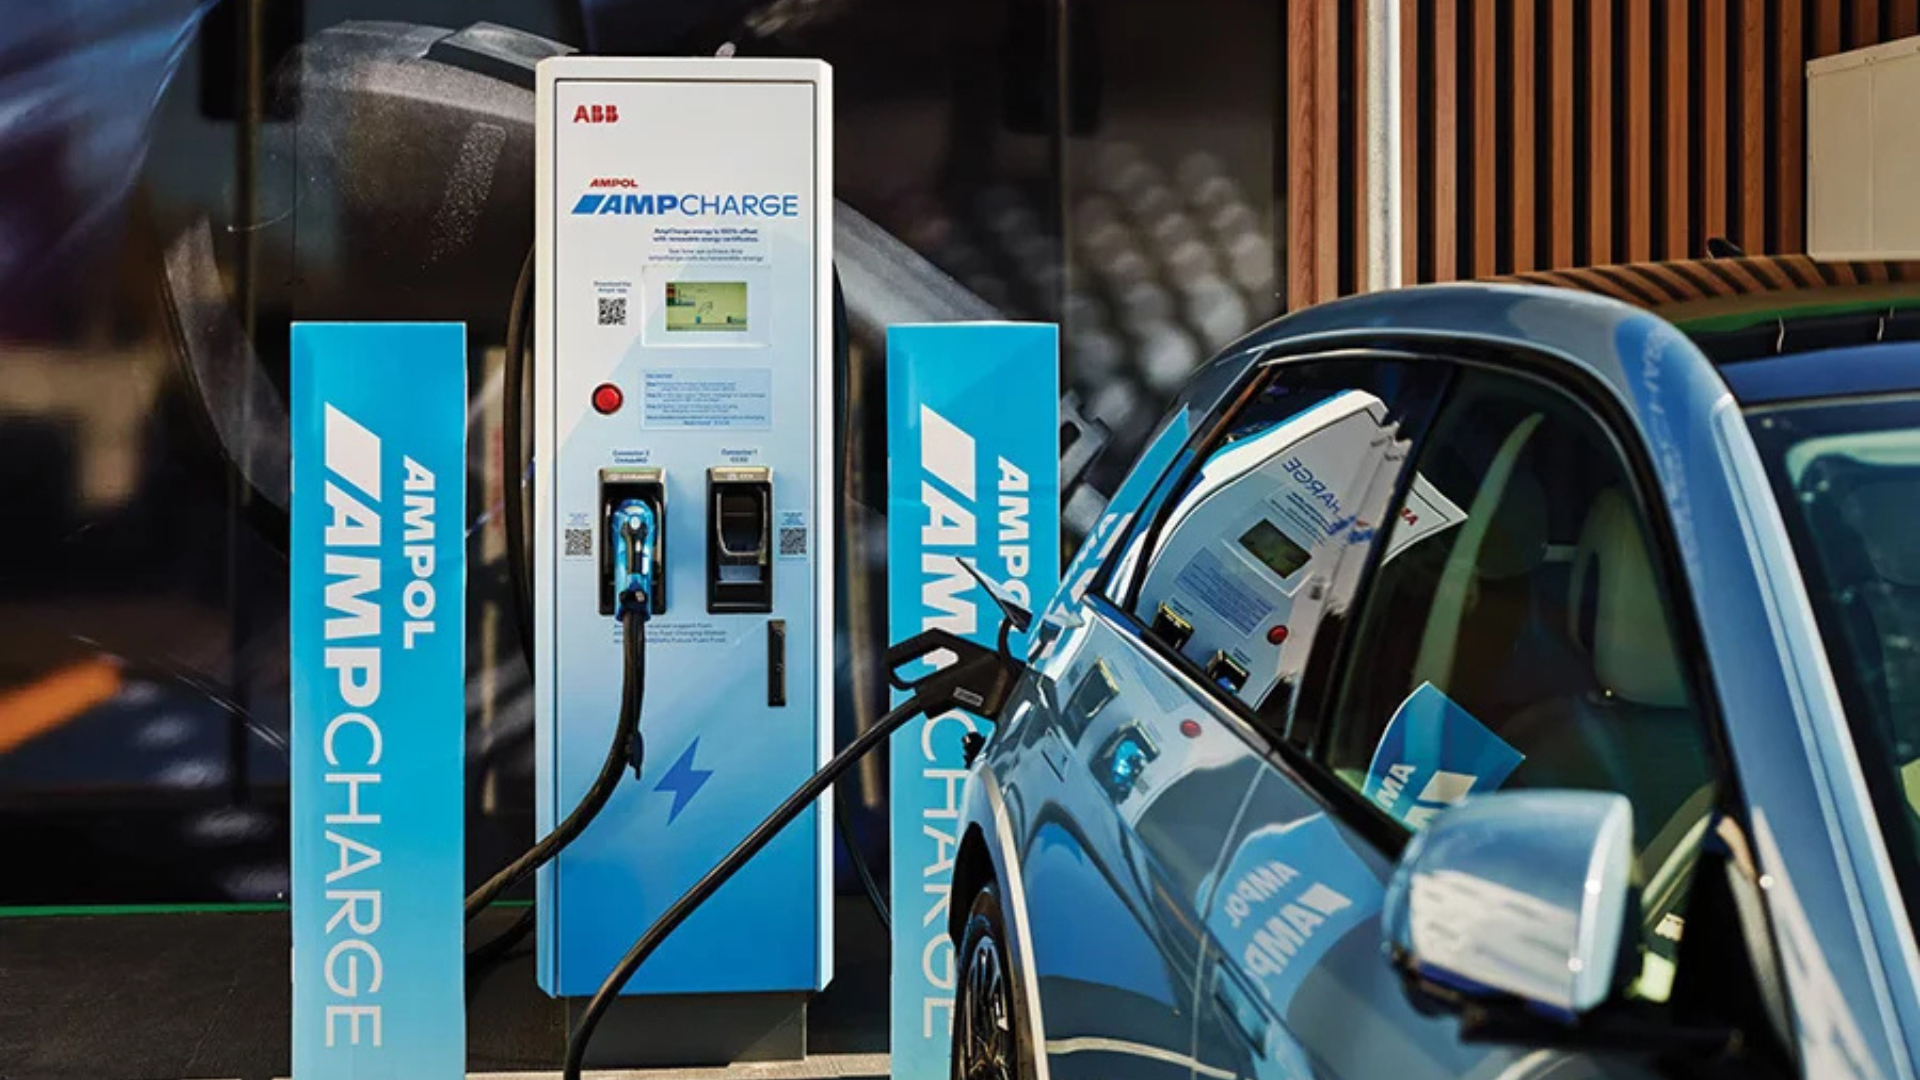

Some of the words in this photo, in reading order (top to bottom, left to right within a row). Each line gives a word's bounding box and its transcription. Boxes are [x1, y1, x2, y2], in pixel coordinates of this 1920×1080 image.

[573, 105, 619, 123] ABB
[589, 178, 638, 188] AMPOL
[599, 194, 799, 216] AMPCHARGE
[403, 454, 436, 650] AMPOL
[998, 455, 1030, 631] AMPO
[324, 480, 382, 1047] AMPCHARGE
